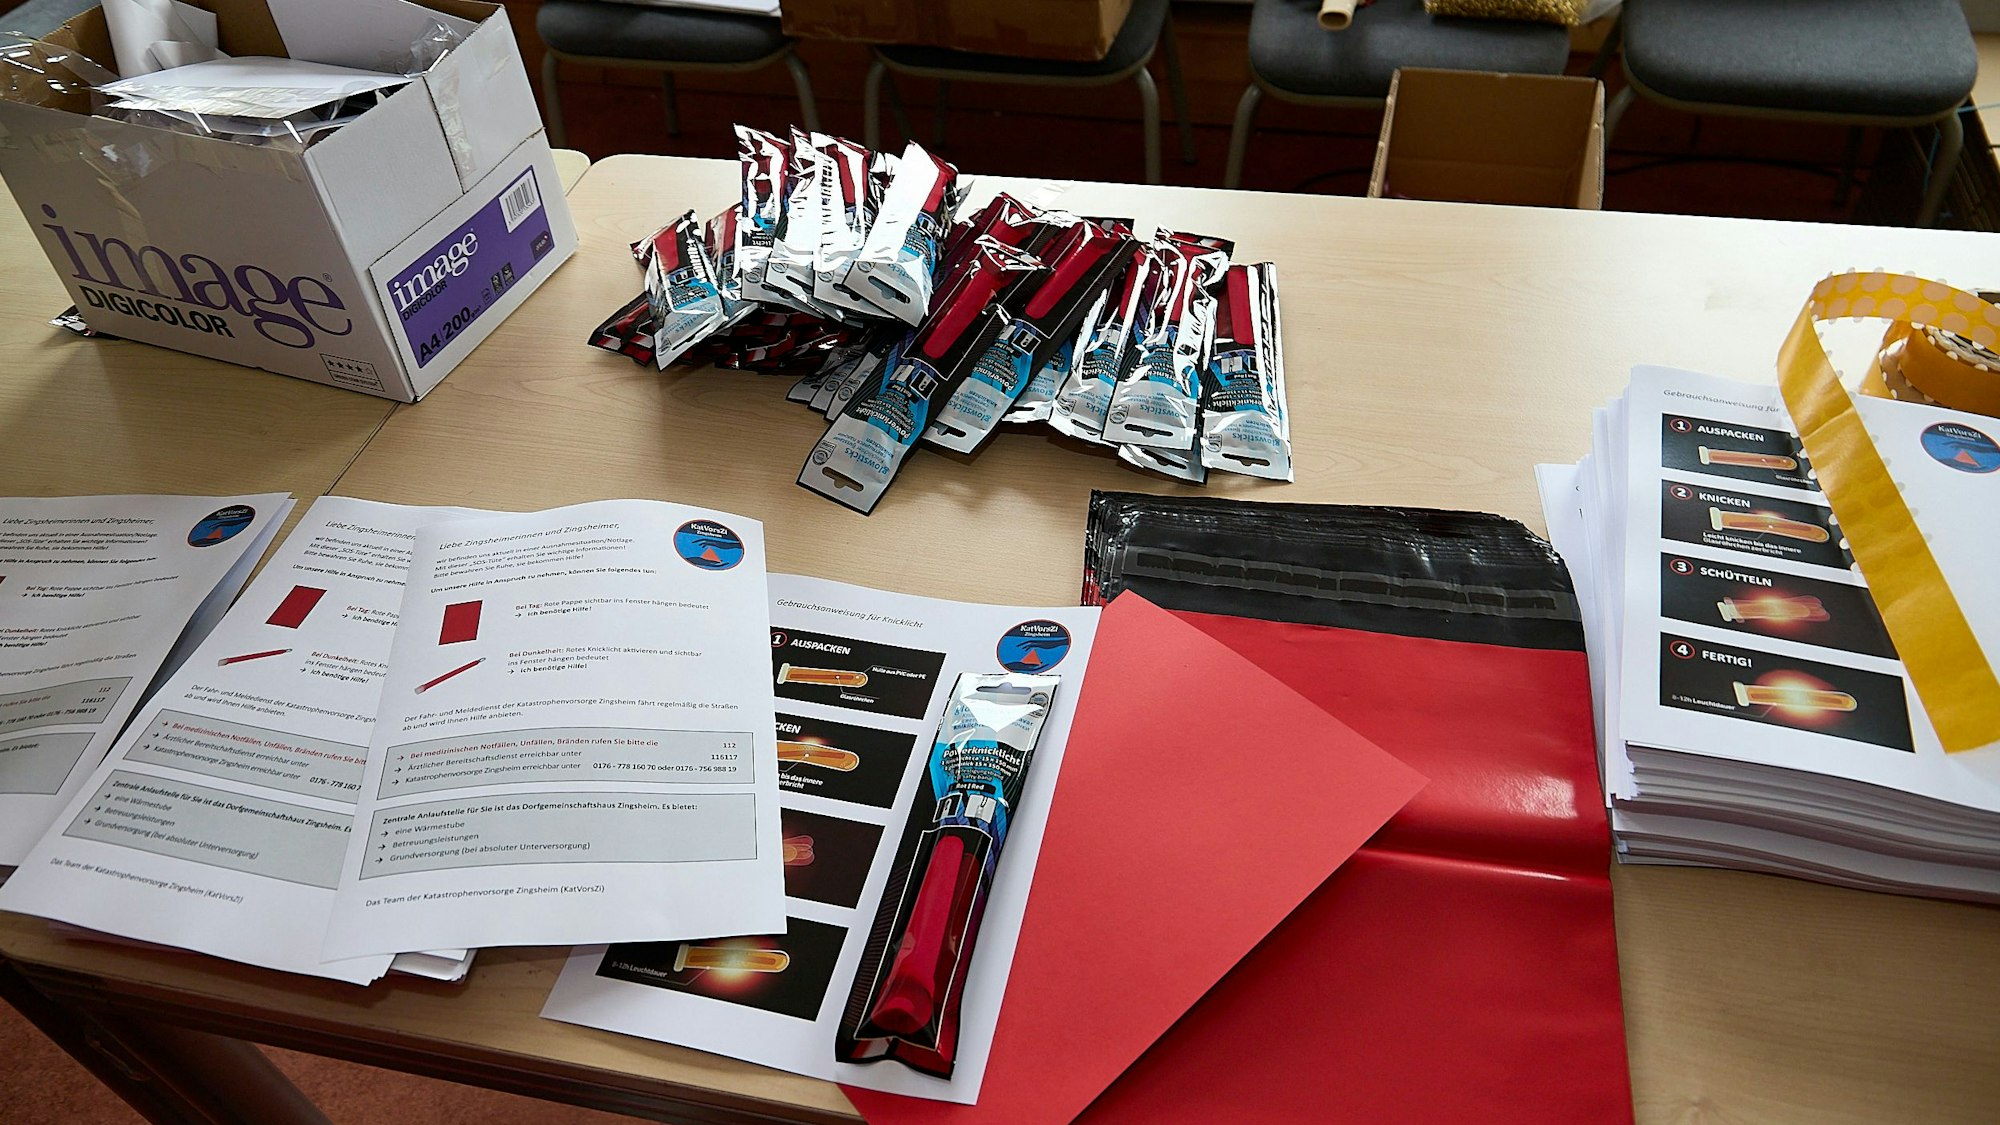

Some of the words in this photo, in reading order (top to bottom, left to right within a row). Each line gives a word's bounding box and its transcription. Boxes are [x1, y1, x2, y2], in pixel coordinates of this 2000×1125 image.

[42, 204, 352, 348] image
[393, 232, 478, 312] image
[403, 280, 448, 321] DIGICOLOR
[79, 285, 235, 338] DIGICOLOR
[1663, 389, 1764, 412] Gebrauchsanweisung
[948, 401, 992, 422] glowsticks
[856, 407, 910, 438] Powerknicklicht
[1677, 421, 1686, 430] 1
[1697, 424, 1764, 442] AUSPACKEN
[1232, 433, 1280, 447] glowsticks
[845, 448, 890, 475] glowsticks
[1677, 488, 1686, 497] 2
[1698, 492, 1750, 508] KNICKEN
[464, 532, 543, 546] Zingsheimerinnen
[545, 527, 563, 536] und
[564, 523, 619, 533] Zingsheimer,
[1703, 532, 1724, 540] Leicht
[1725, 536, 1752, 545] knicken
[1779, 544, 1801, 553] innere
[1751, 545, 1783, 555] zerbricht
[1677, 562, 1687, 572] 3
[1700, 566, 1772, 587] SCHÜTTELN
[777, 598, 865, 619] Gebrauchsanweisung
[866, 613, 881, 621] für
[882, 616, 924, 628] Knicklicht
[1020, 624, 1058, 633] KatVorsZi
[772, 635, 781, 645] 1
[790, 638, 851, 655] AUSPACKEN
[1677, 645, 1688, 655] 4
[1702, 650, 1752, 668] FERTIG!
[321, 671, 350, 681] benötige
[1693, 698, 1735, 710] Leuchtdauer
[424, 746, 479, 757] medizinischen
[480, 742, 518, 750] Notfällen,
[520, 738, 555, 747] Unfällen,
[408, 762, 444, 771] Ärztlicher
[446, 754, 518, 766] Bereitschaftsdienst
[405, 769, 483, 783] Katastrophenvorsorge
[484, 765, 521, 774] Zingsheim
[803, 777, 823, 785] innere
[383, 814, 416, 824] Zentrale
[417, 809, 465, 819] Anlaufstelle
[522, 802, 616, 810] Dorfgemeinschaftshaus
[414, 822, 465, 832] Wärmestube
[392, 834, 479, 848] Betreuungsleistungen
[390, 849, 460, 861] Grundversorgung
[461, 847, 478, 855] (bei
[520, 842, 590, 851] Unterversorgung)
[423, 889, 514, 900] Katastrophenvorsorge
[516, 886, 558, 895] Zingsheim
[560, 885, 605, 894] (KatVorsZi)
[630, 965, 668, 977] Leuchtdauer
